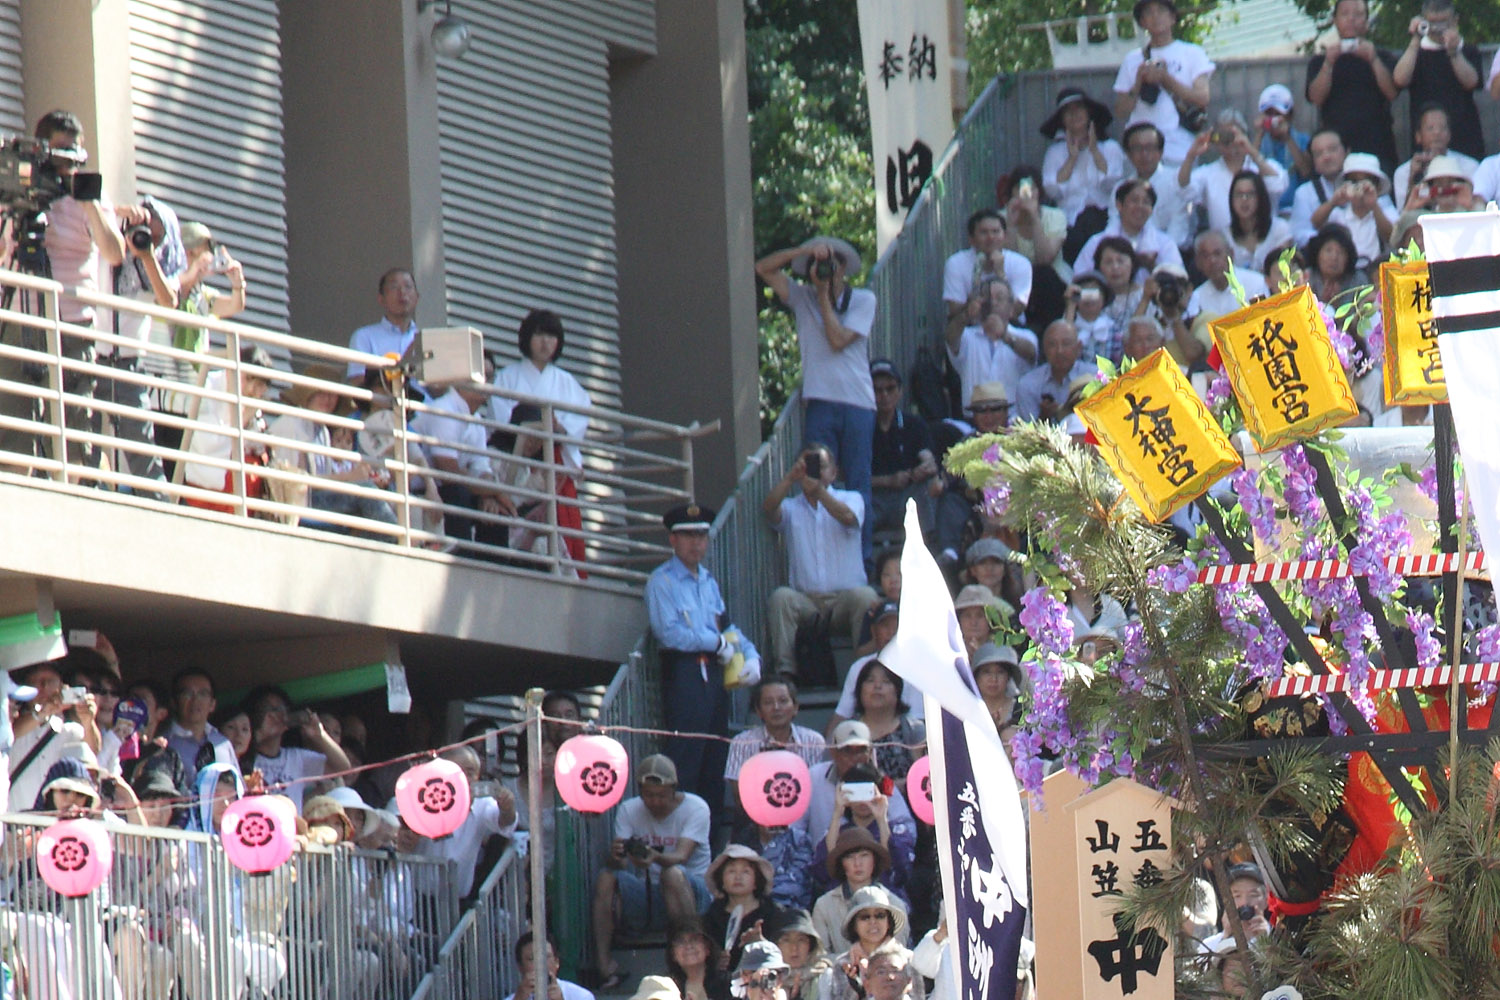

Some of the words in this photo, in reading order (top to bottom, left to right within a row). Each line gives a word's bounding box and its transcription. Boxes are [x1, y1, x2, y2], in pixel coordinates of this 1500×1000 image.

[879, 33, 938, 90] 奉納
[1247, 317, 1312, 424] 祇園宮
[1123, 391, 1198, 487] 大神宮
[1085, 819, 1124, 898] 山笠
